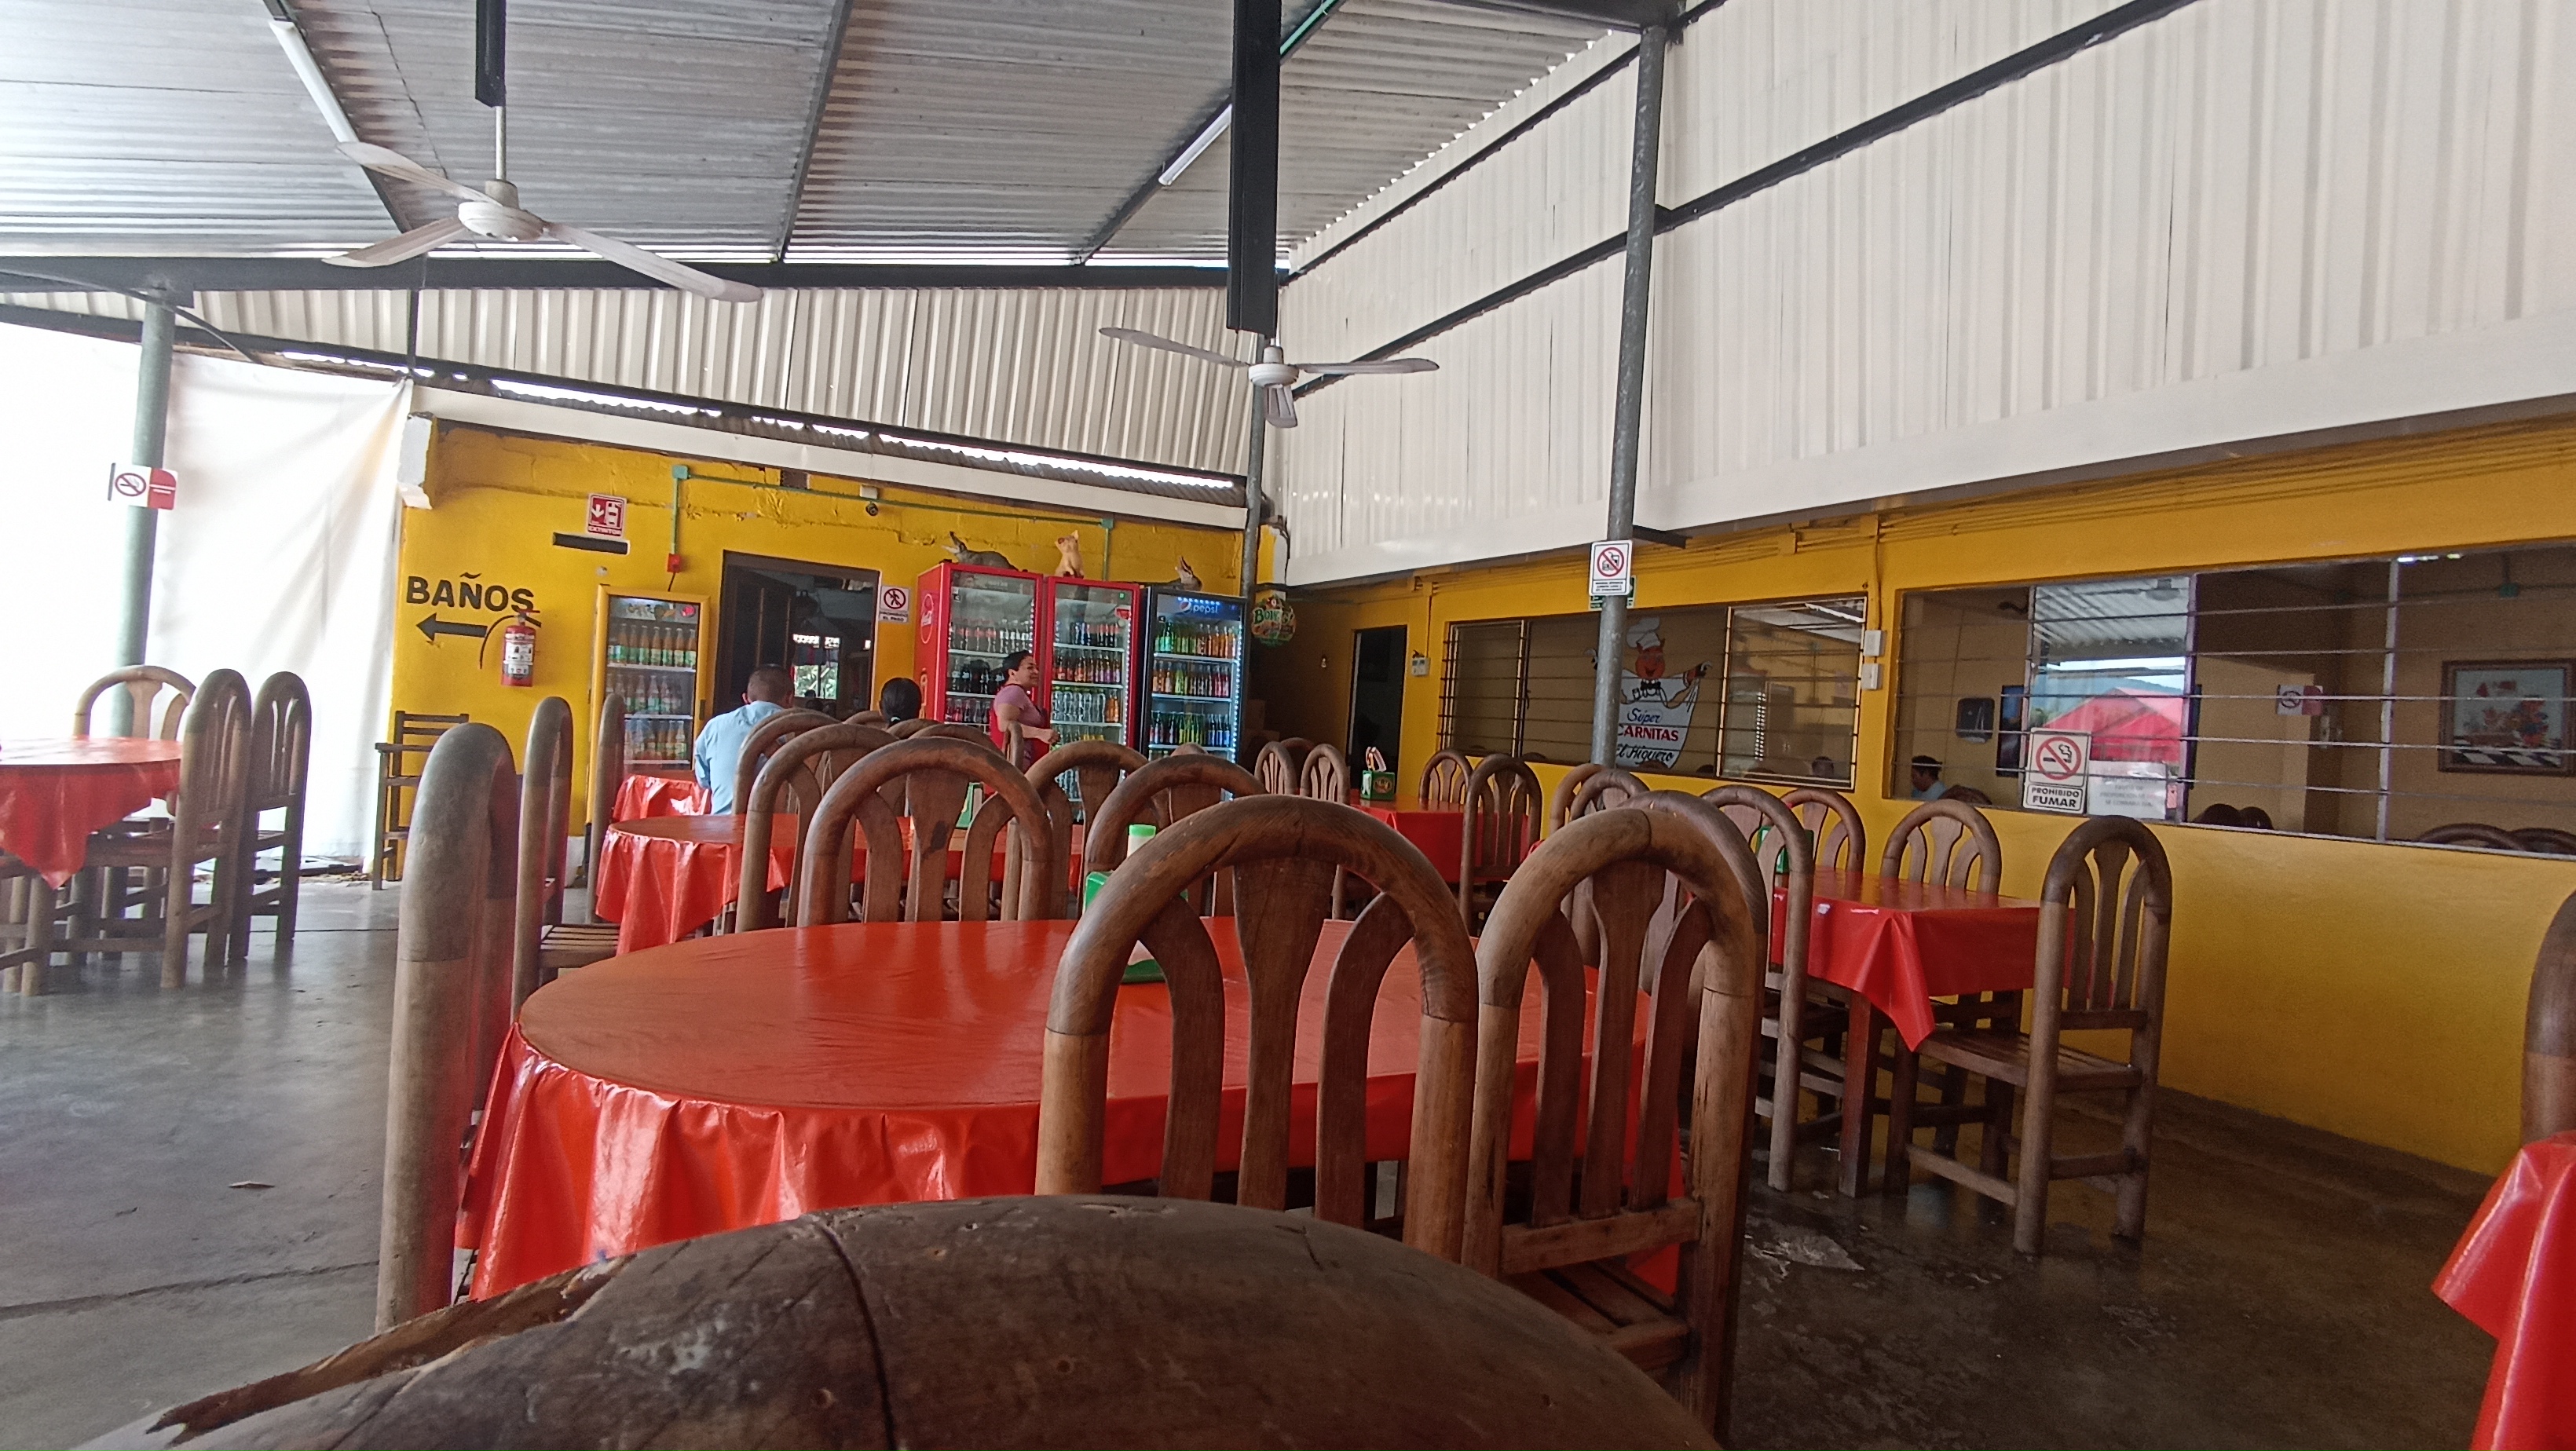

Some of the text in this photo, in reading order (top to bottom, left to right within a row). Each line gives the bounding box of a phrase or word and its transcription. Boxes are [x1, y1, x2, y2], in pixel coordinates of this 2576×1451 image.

[406, 572, 534, 613] BAÑOS
[1192, 604, 1218, 615] pepsi
[2031, 786, 2080, 799] PROHIBIDO
[2032, 795, 2077, 809] FUMAR
